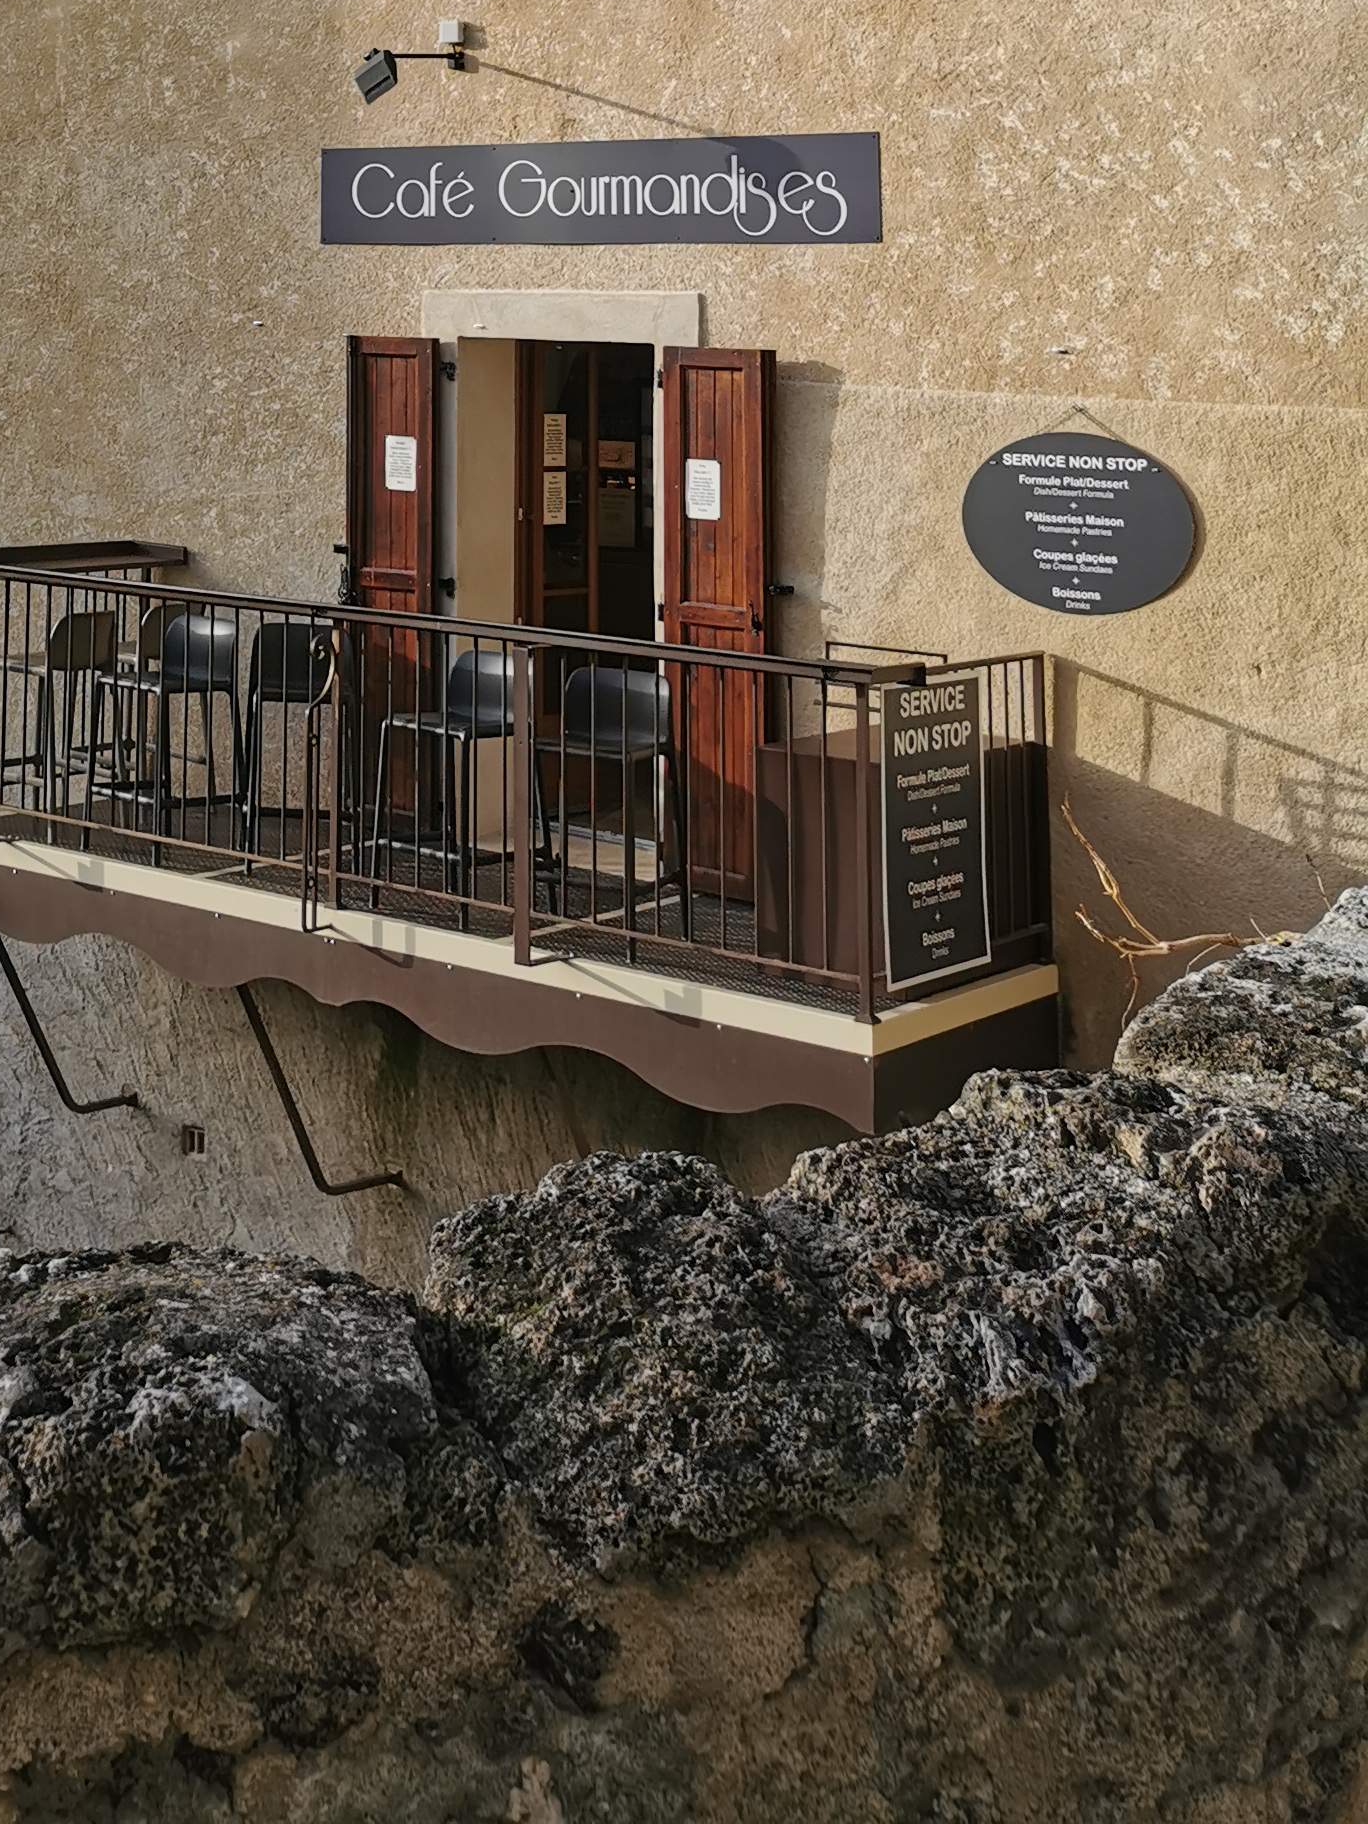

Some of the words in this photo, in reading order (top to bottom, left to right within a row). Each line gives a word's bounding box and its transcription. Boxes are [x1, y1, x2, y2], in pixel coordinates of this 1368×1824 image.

[351, 161, 475, 218] Café
[498, 154, 848, 236] Gourmandises
[1002, 453, 1066, 468] SERVICE
[1069, 456, 1103, 470] NON
[1106, 457, 1148, 471] STOP
[1019, 474, 1061, 486] Formule
[1063, 476, 1130, 490] Plat/Dessert
[1083, 489, 1114, 499] Formula
[1025, 510, 1083, 525] Pâtisseries
[1085, 514, 1124, 527] Maison
[1037, 524, 1080, 534] Homemade
[1033, 548, 1074, 562] Coupes
[1039, 561, 1051, 570] Ice
[1053, 562, 1078, 572] Cream
[1052, 586, 1101, 600] Boissons
[1065, 600, 1091, 610] Drinks
[900, 685, 965, 718] SERVICE
[894, 726, 928, 757] NON
[932, 720, 971, 750] STOP
[922, 928, 955, 946] Boissons
